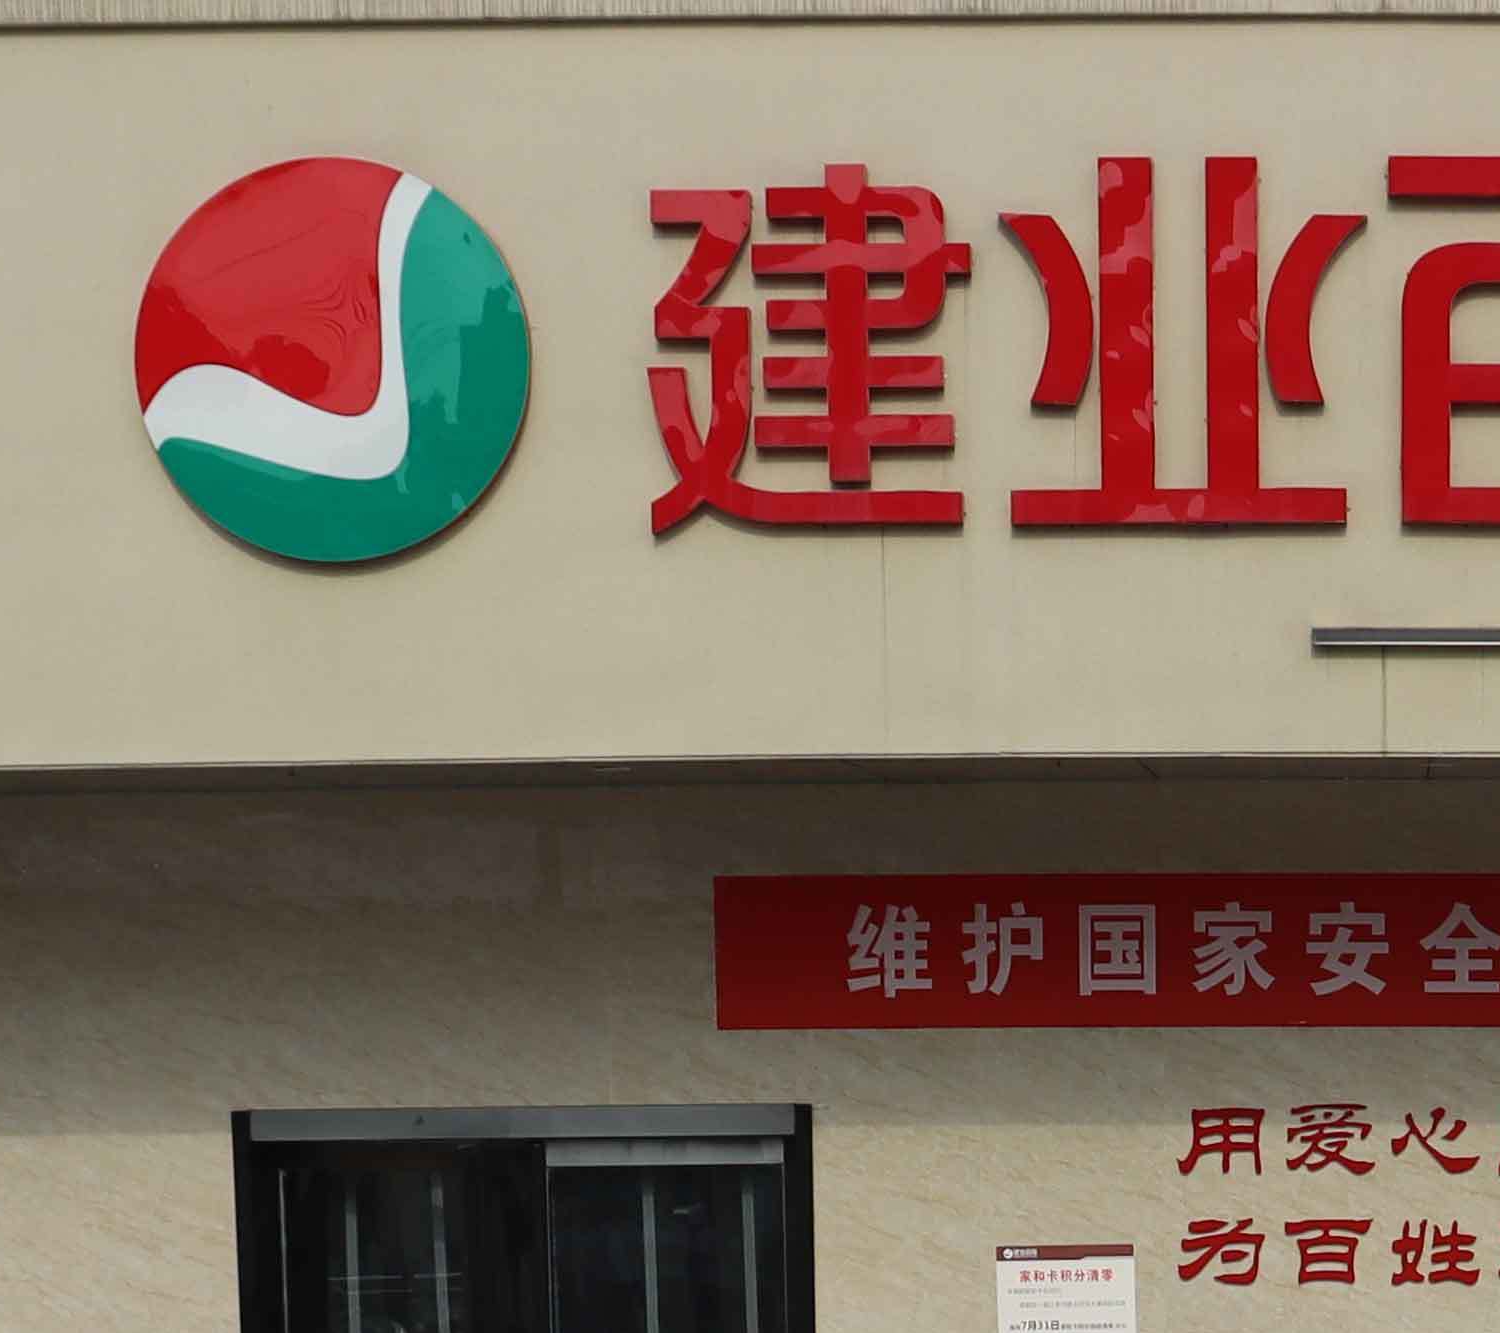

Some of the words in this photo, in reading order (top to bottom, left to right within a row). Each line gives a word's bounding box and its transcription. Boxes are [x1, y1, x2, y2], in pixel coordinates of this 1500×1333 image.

[1019, 1269, 1114, 1284] 家和卡积分清零
